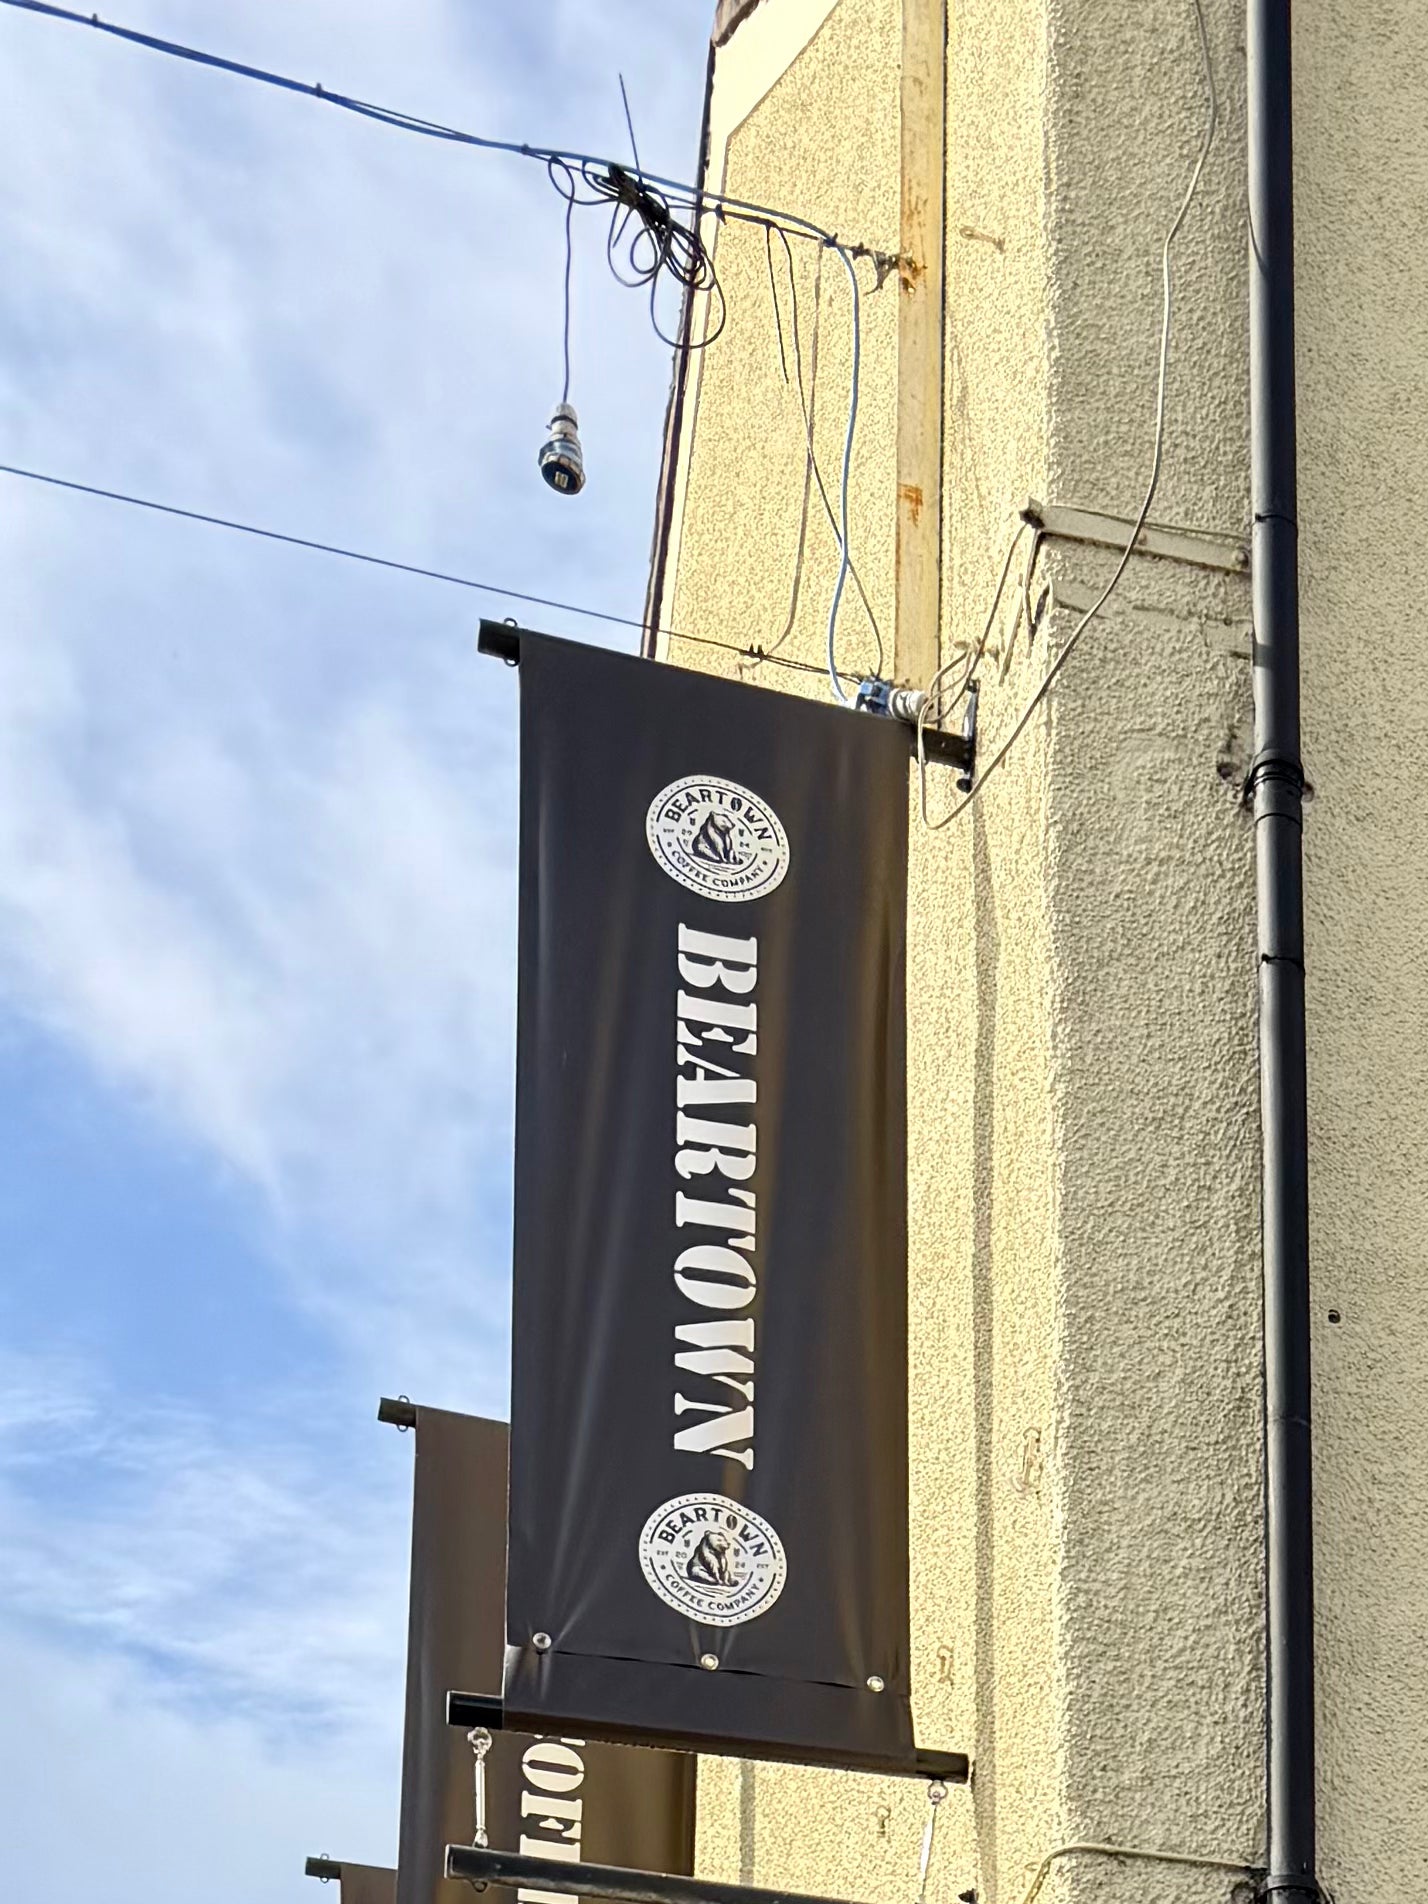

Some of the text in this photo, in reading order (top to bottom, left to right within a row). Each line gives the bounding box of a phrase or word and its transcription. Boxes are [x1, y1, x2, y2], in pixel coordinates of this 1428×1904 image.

[665, 789, 772, 840] BEARTOWN
[671, 850, 764, 889] COFFEE COMPANY
[674, 922, 757, 1470] BEARTOWN
[658, 1507, 768, 1557] BEARTOWN
[665, 1573, 761, 1611] COFFEE COMPANY
